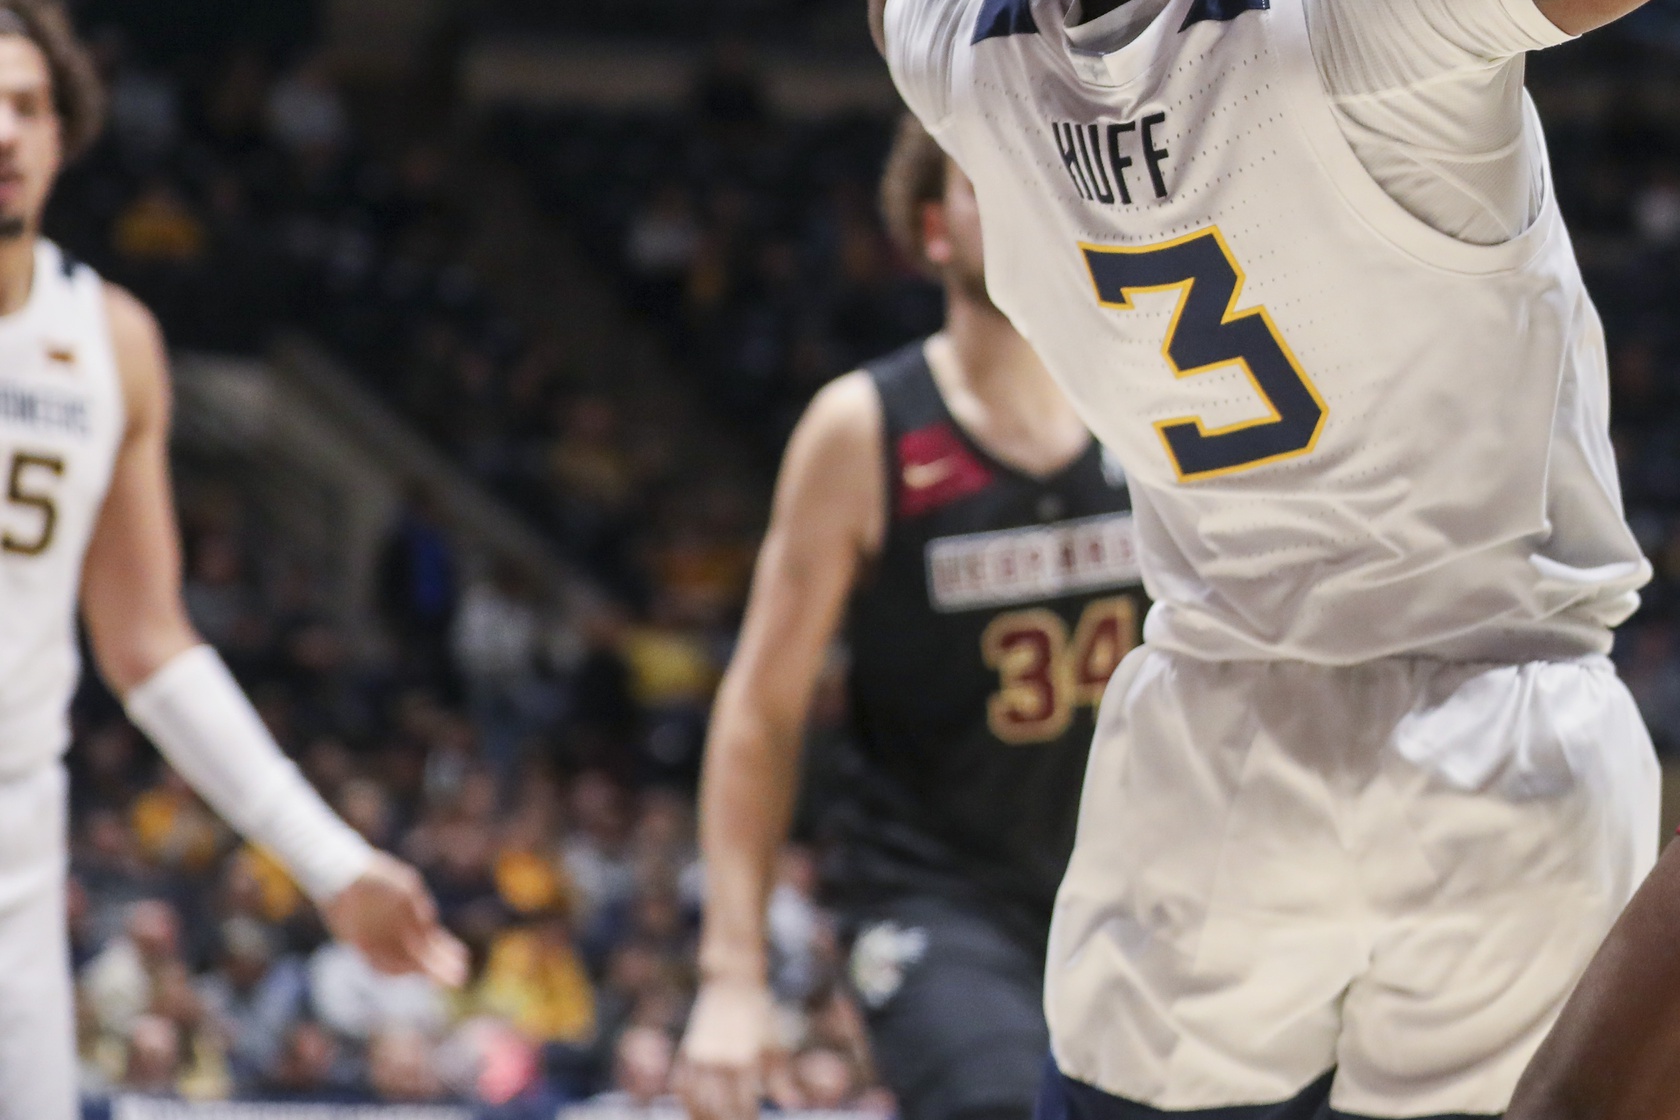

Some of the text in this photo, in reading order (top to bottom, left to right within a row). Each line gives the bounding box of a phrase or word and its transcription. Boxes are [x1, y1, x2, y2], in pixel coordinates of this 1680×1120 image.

[1051, 112, 1169, 205] HUFF
[1077, 224, 1330, 482] 3
[979, 595, 1143, 745] 34
